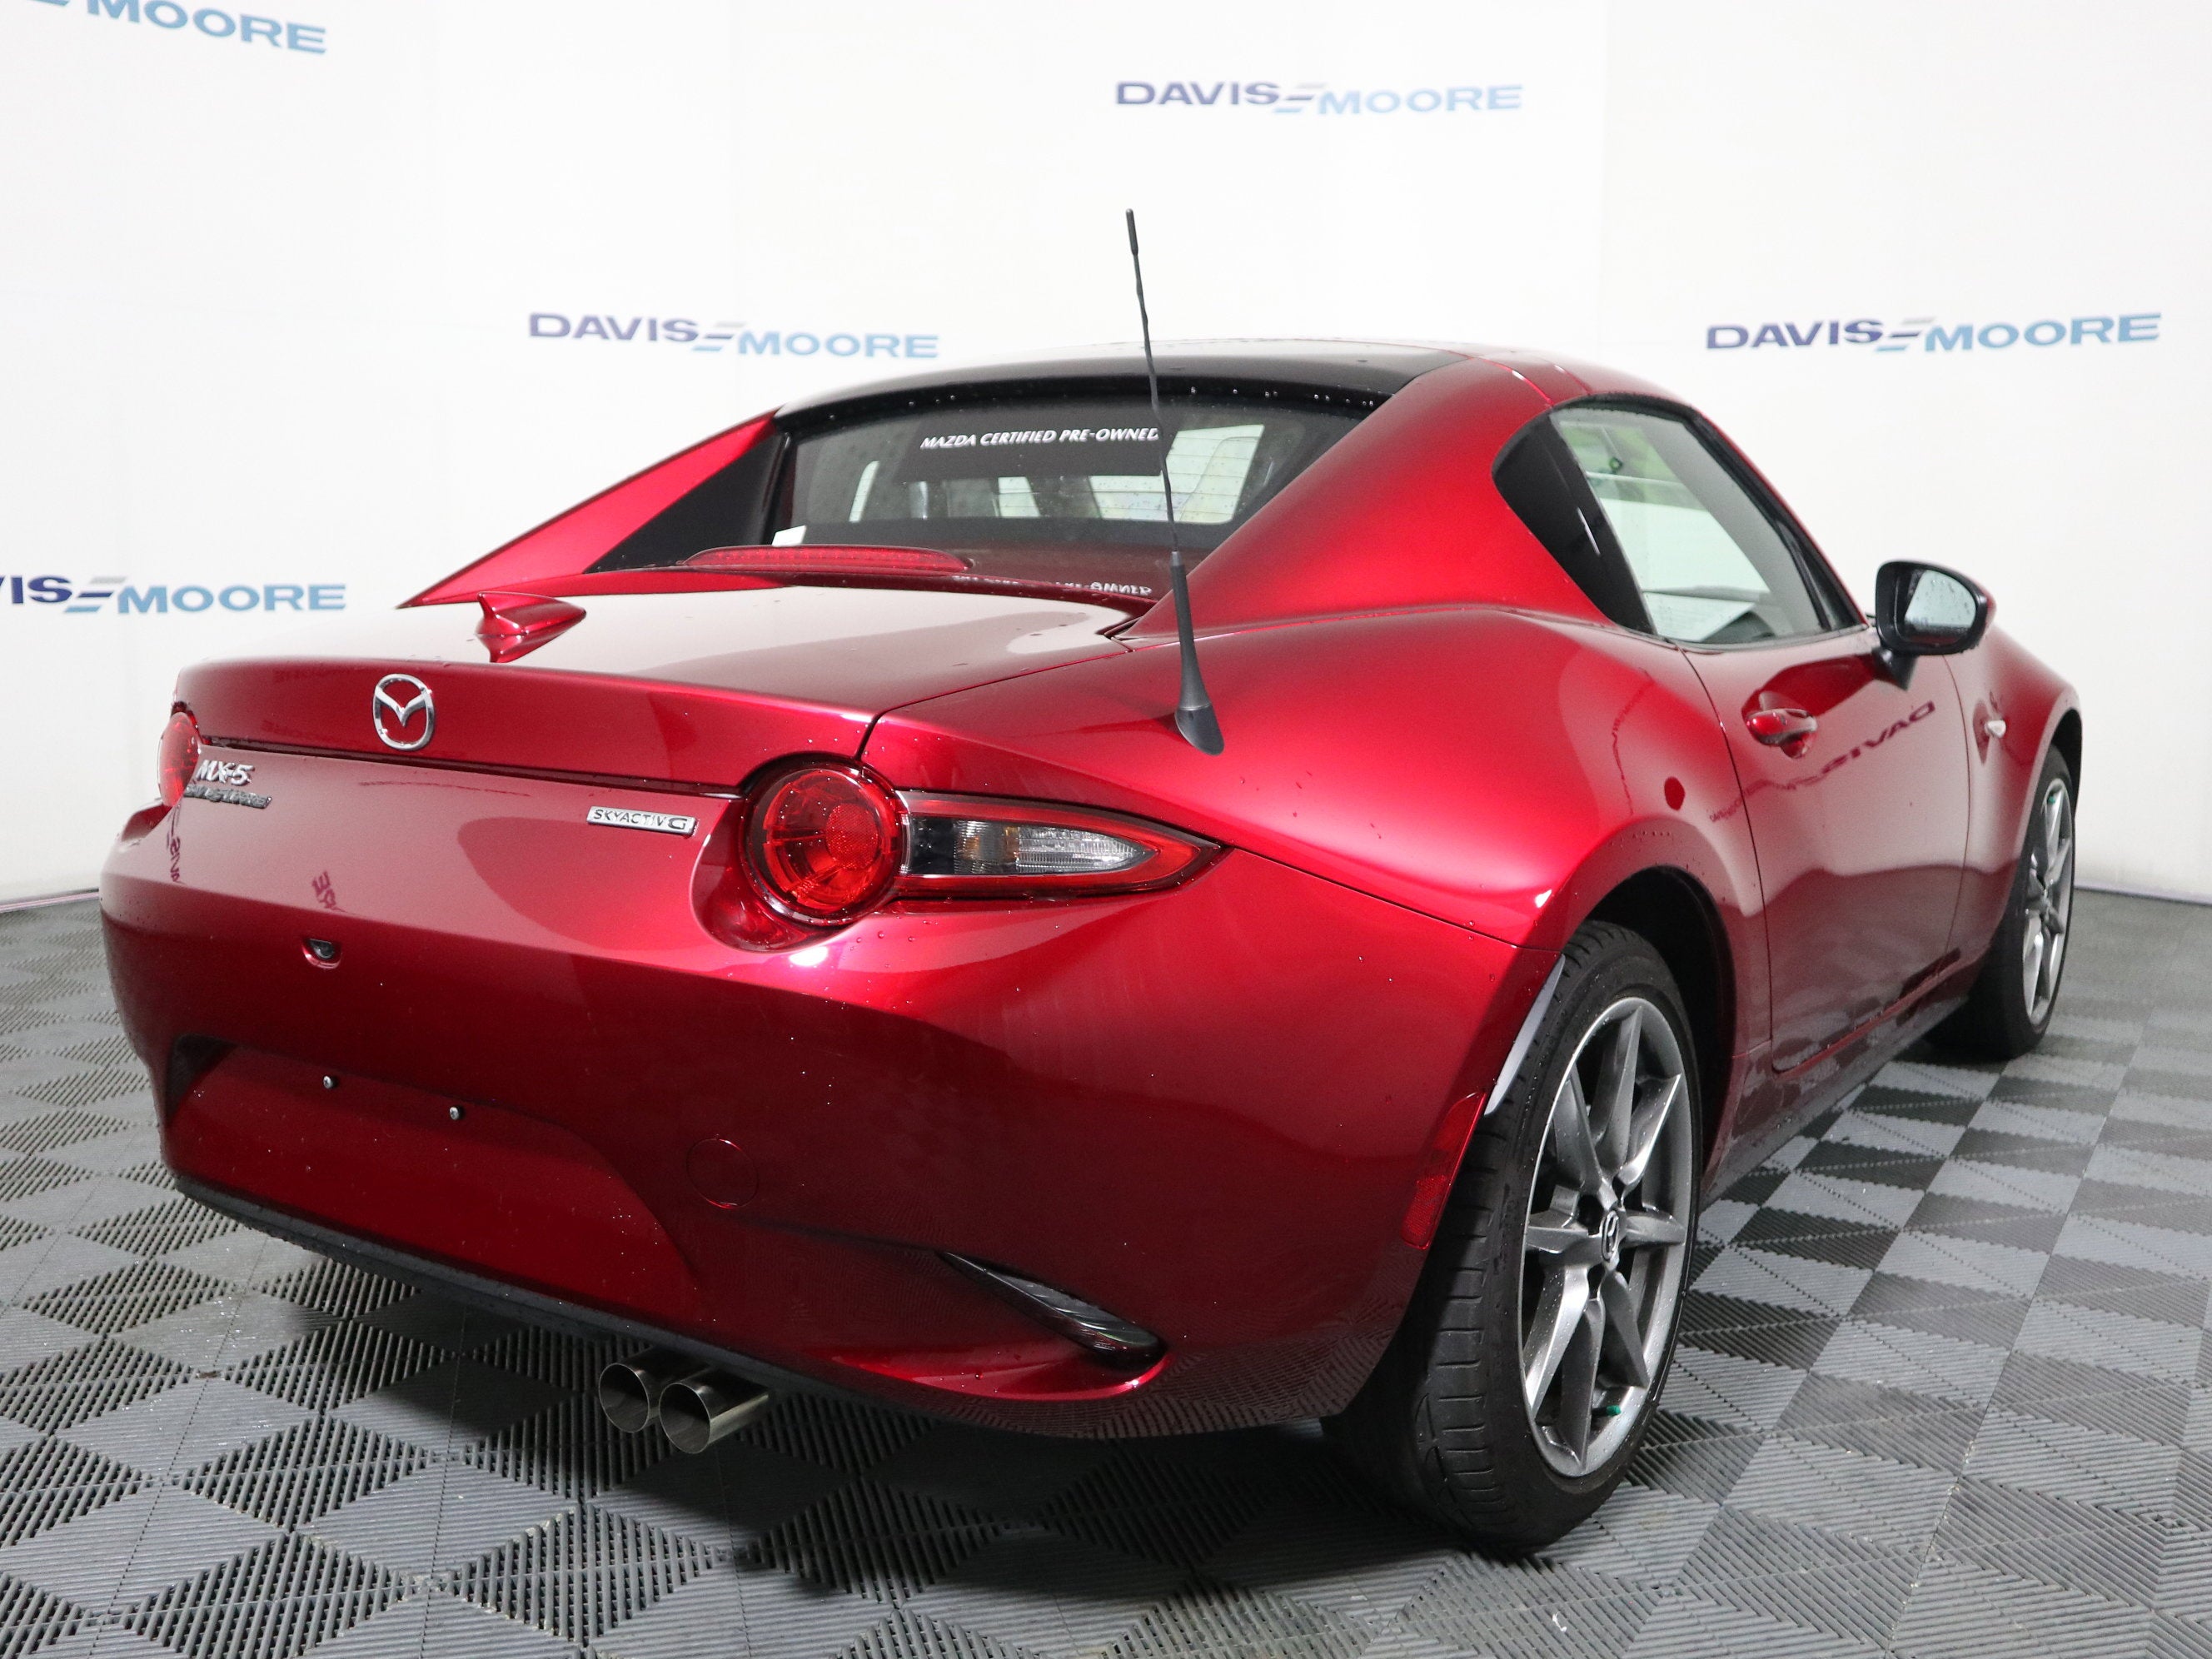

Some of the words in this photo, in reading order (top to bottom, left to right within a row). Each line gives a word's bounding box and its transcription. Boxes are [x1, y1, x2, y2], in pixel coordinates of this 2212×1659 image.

[87, 0, 326, 54] MOORE
[1116, 81, 1279, 106] DAVIS
[1318, 85, 1522, 114] MOORE
[529, 312, 699, 341] DAVIS
[738, 331, 939, 358] MOORE
[1706, 319, 1883, 350] DAVIS
[1924, 311, 2162, 352] MOORE
[919, 433, 976, 450] MAZDA
[979, 430, 1056, 446] CERTIFIED
[117, 584, 346, 614] MOORE
[195, 759, 256, 786] MX-5
